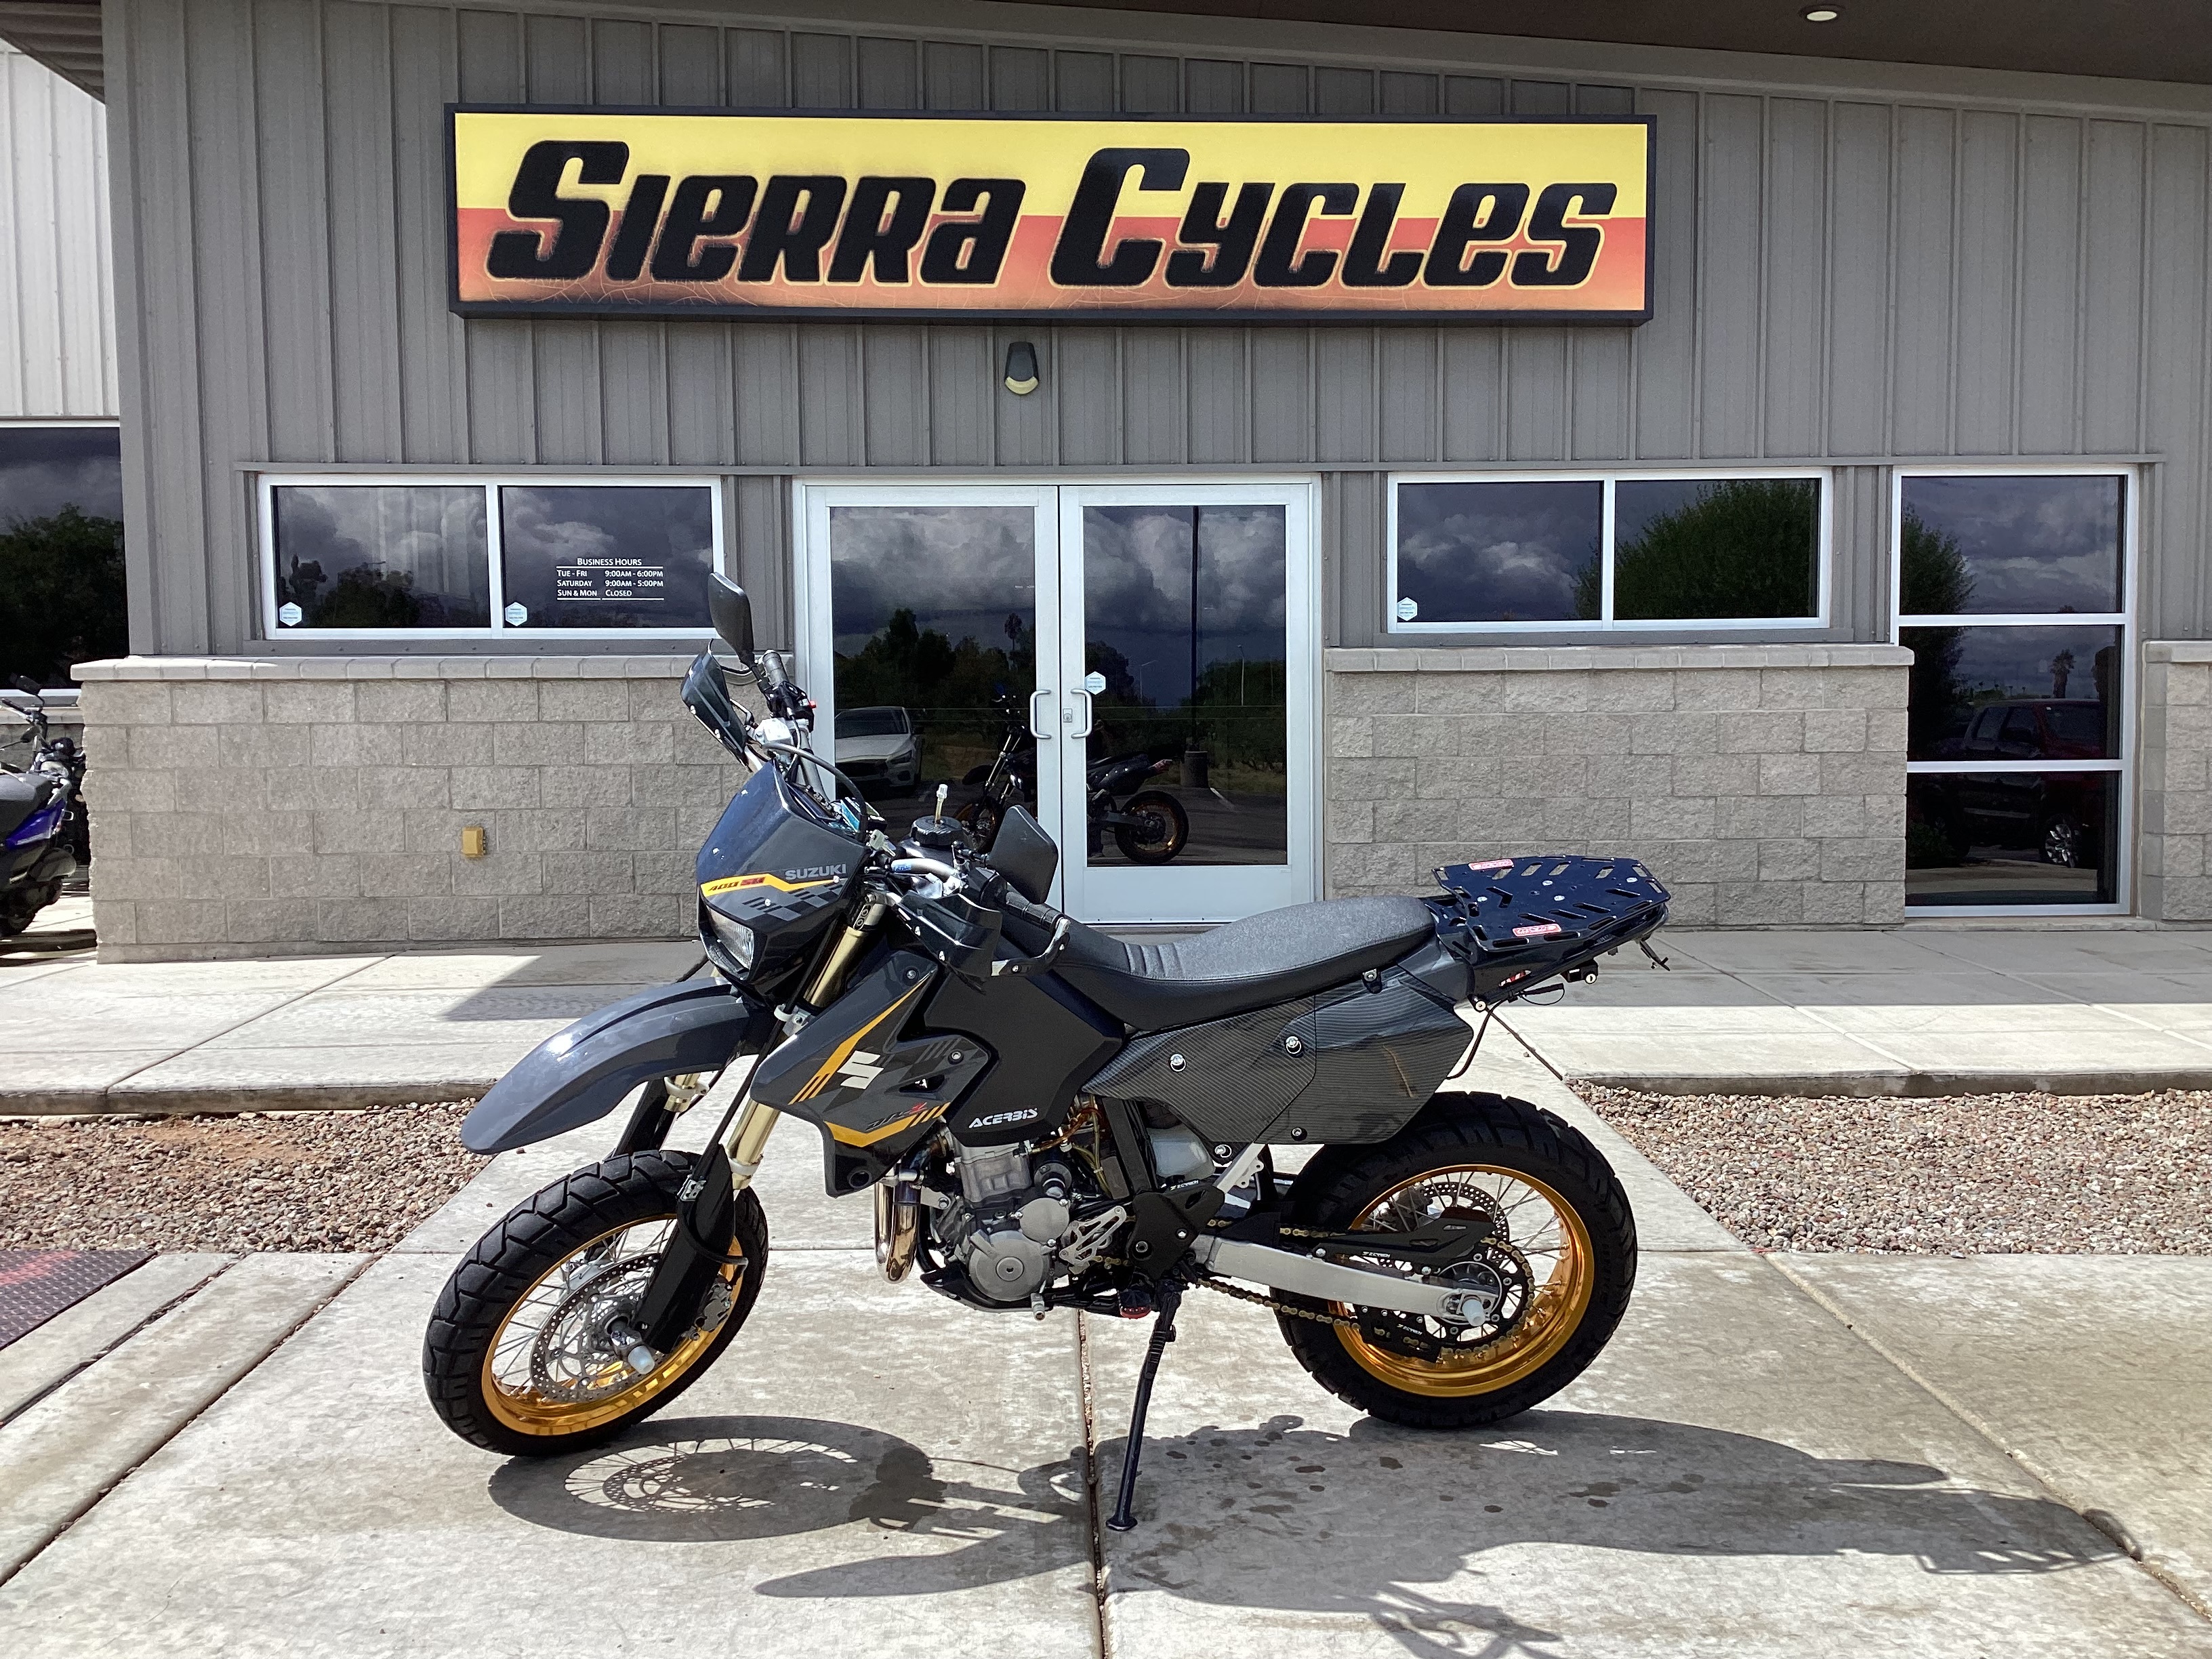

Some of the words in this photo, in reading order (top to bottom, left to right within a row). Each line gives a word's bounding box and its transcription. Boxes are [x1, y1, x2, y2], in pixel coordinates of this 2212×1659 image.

[577, 558, 613, 566] BUSINESS
[615, 558, 642, 566] HOURS
[785, 863, 846, 880] SUZUKI
[968, 1107, 1038, 1129] ACERBIS
